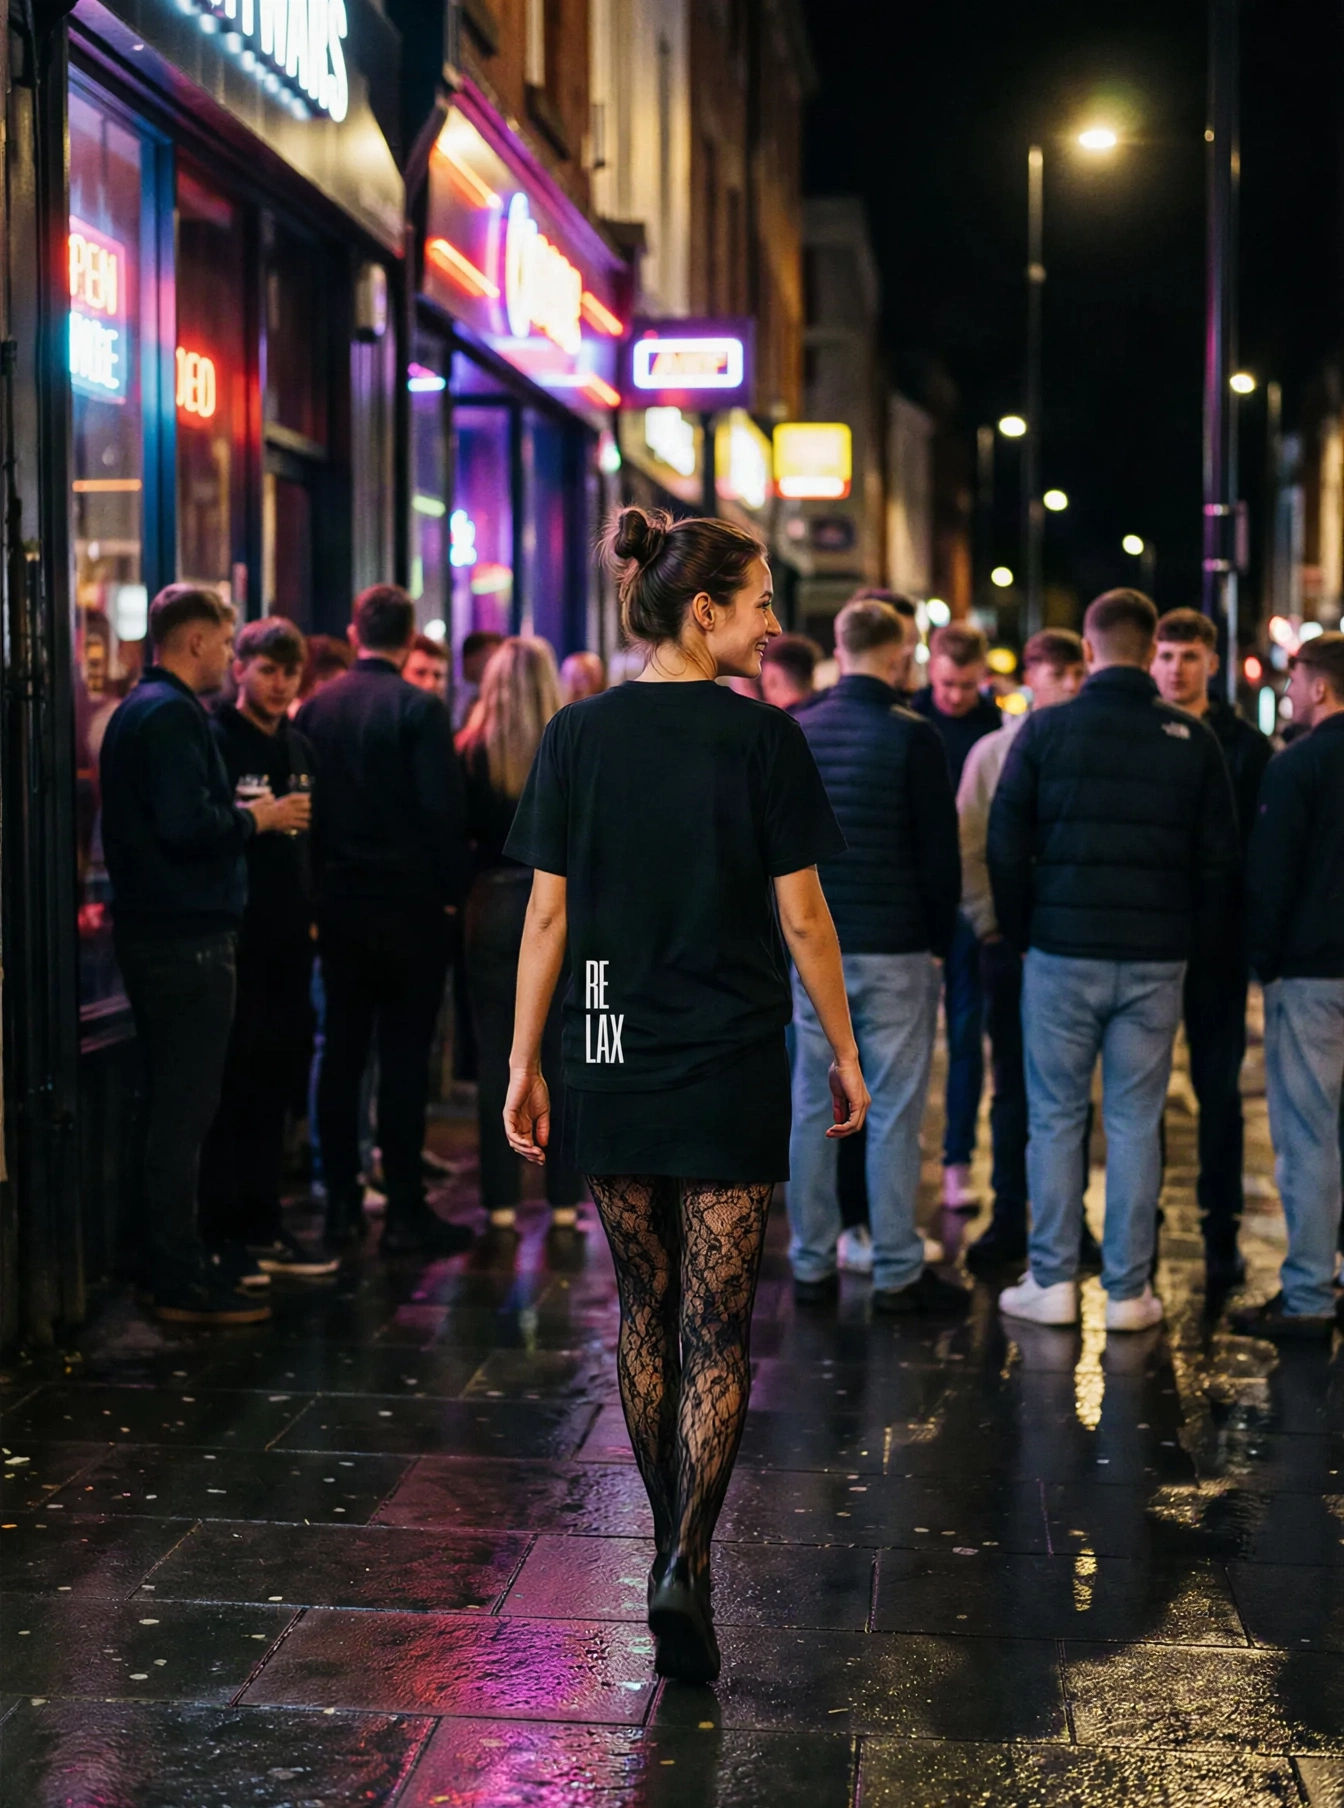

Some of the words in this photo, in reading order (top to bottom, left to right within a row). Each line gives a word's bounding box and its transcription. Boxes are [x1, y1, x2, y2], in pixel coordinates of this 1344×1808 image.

[68, 232, 118, 316] PEN
[585, 960, 610, 1010] RE
[585, 1014, 625, 1064] LAX
